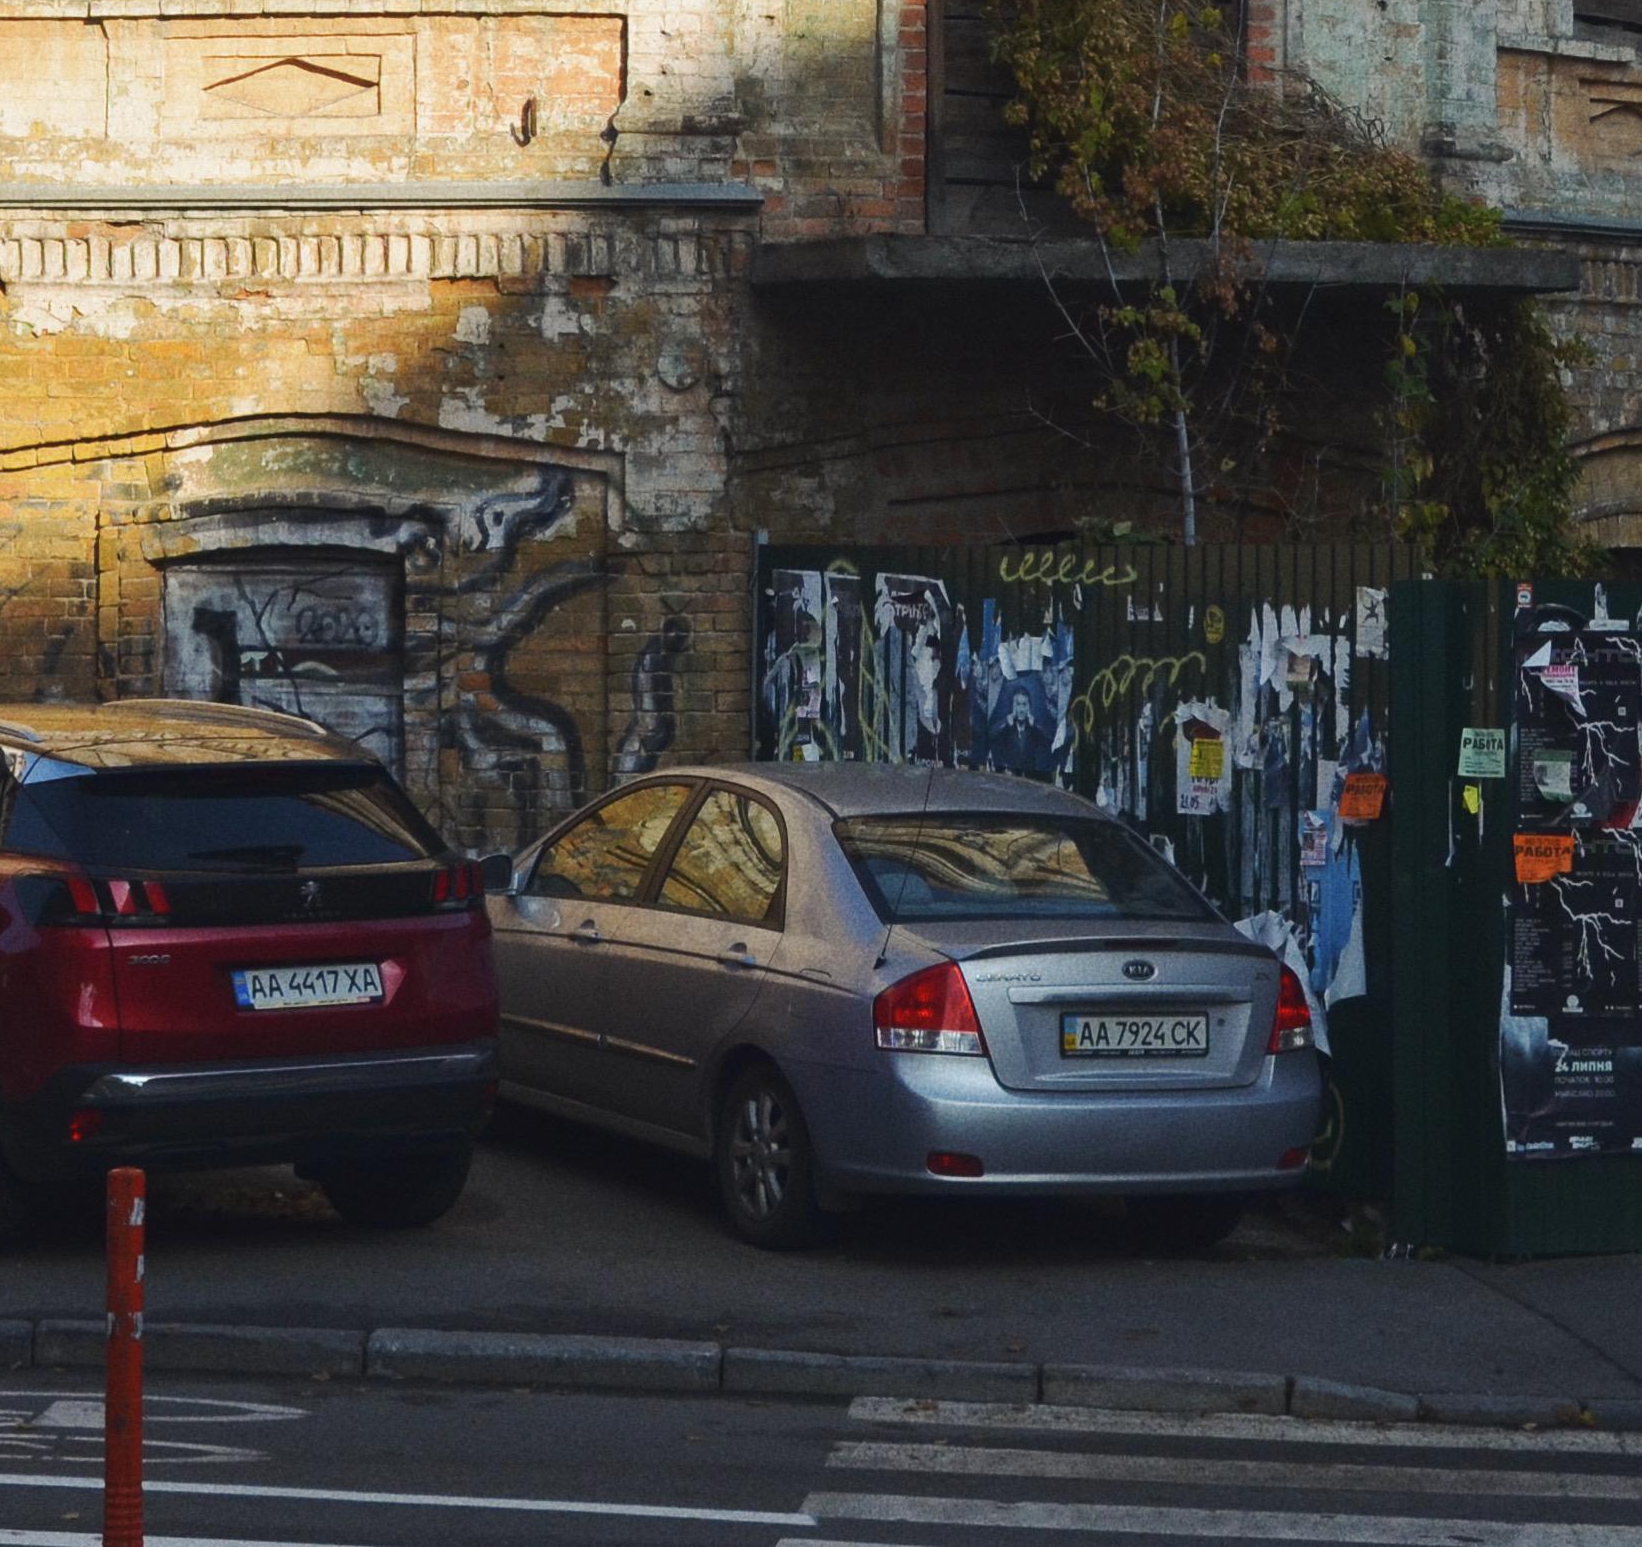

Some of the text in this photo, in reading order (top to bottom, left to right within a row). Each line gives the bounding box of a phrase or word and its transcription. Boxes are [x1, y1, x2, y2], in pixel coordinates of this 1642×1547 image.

[1463, 737, 1504, 750] РАБОТА
[1128, 965, 1151, 975] KIA
[252, 968, 378, 999] AA 4417 XA
[1079, 1020, 1202, 1047] AA 7924 CK
[1571, 1060, 1613, 1072] ЛИПНЯ
